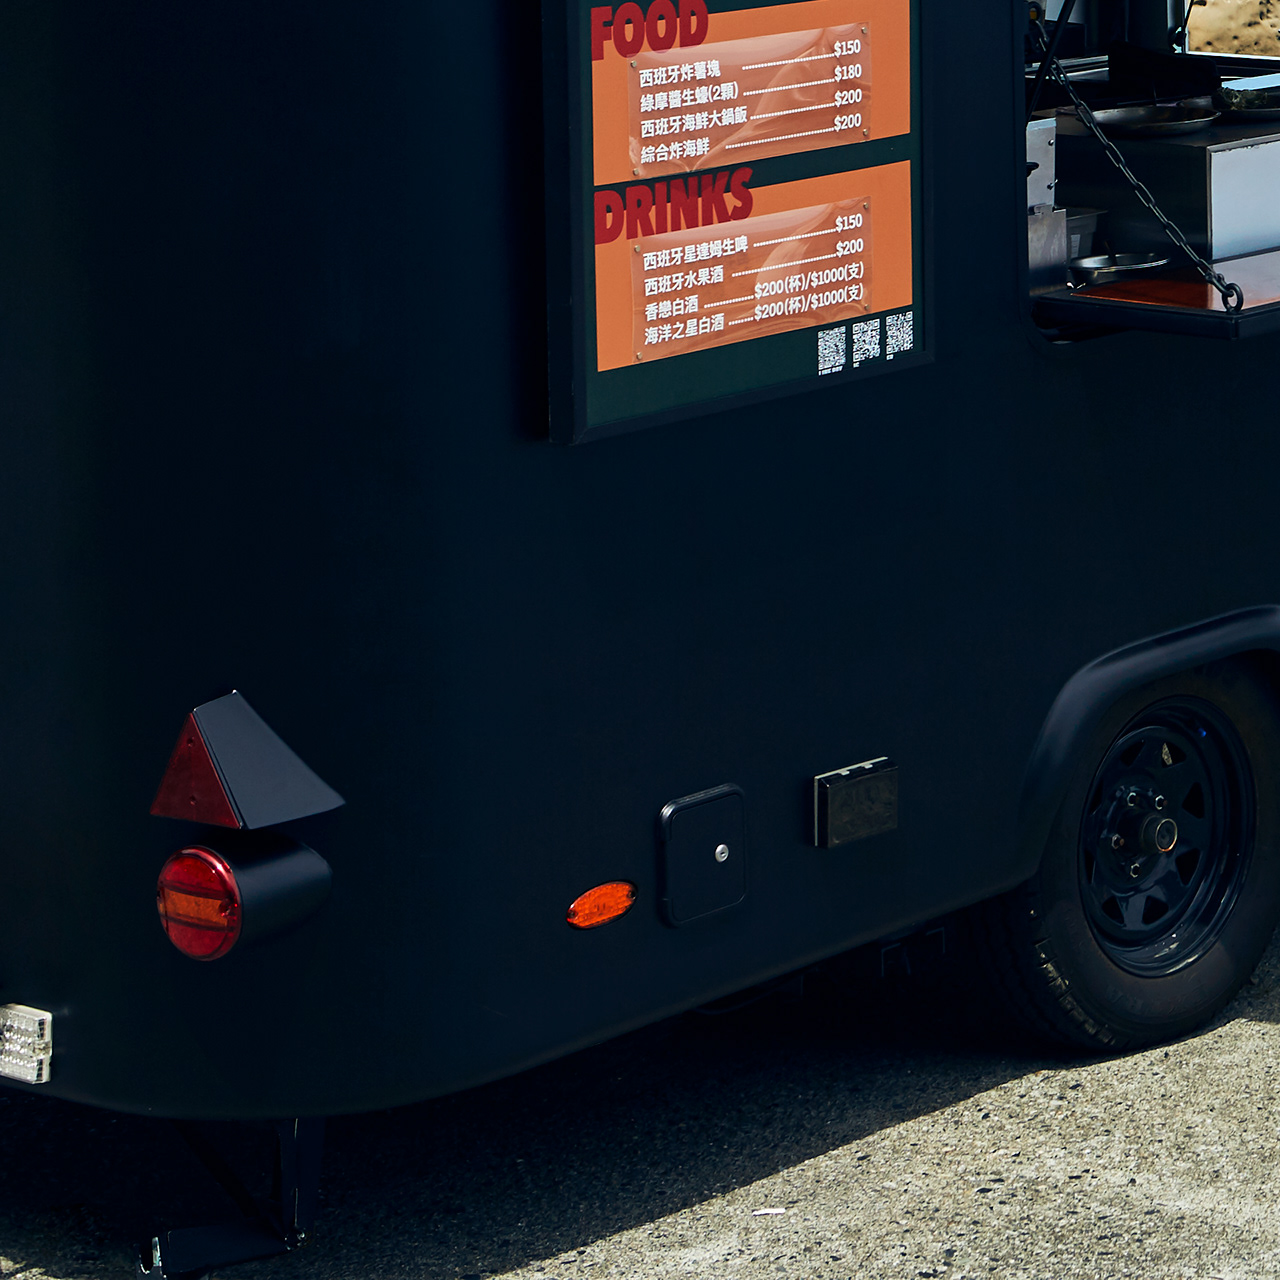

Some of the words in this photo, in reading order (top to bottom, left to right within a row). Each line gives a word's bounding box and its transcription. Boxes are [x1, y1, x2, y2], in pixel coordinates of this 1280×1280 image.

[639, 59, 721, 88] 西班牙炸薯塊
[834, 39, 861, 58] $150
[834, 63, 862, 83] $180
[641, 106, 748, 138] 西班牙海鮮大鍋飯
[834, 88, 862, 108] $200
[641, 137, 710, 164] 綜合炸海鮮
[834, 113, 862, 133] $200
[594, 167, 753, 245] DRINKS
[643, 235, 748, 271] 西班牙星達姆生啤
[835, 213, 863, 233] $150
[644, 265, 724, 296] 西班牙水果酒
[836, 238, 864, 258] $200
[644, 313, 725, 345] 海洋之星白酒
[645, 295, 699, 322] 香戀白酒
